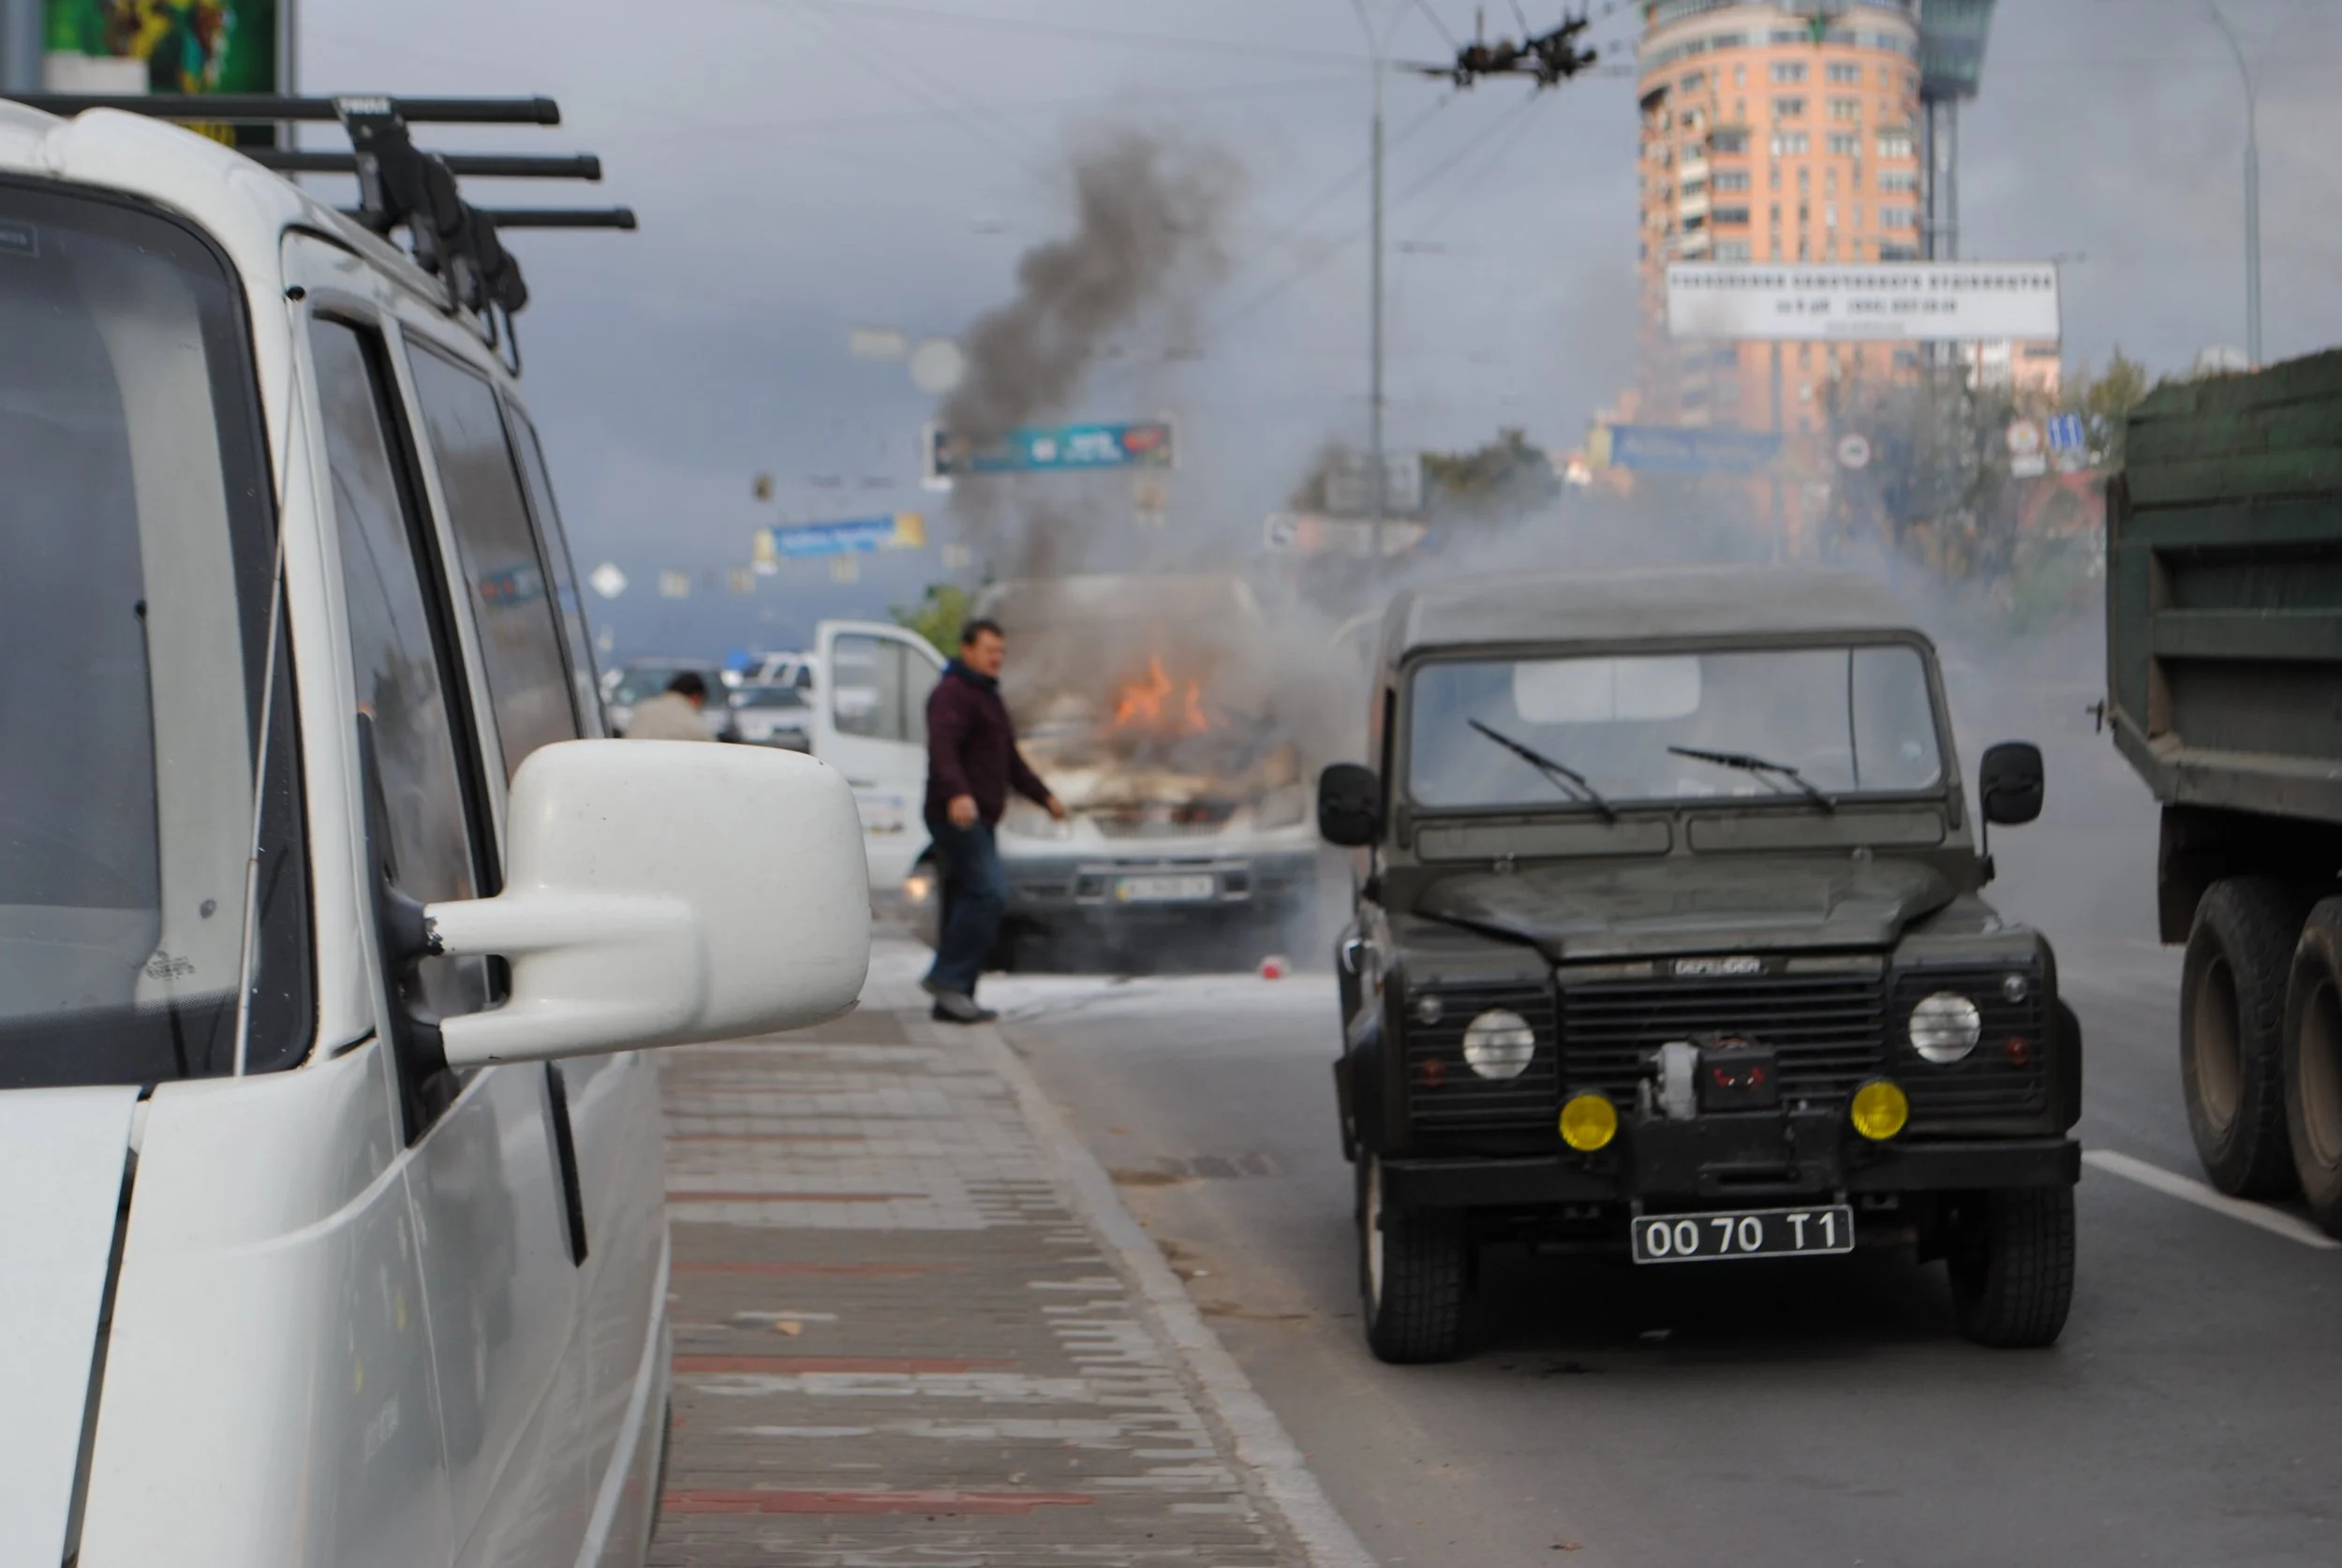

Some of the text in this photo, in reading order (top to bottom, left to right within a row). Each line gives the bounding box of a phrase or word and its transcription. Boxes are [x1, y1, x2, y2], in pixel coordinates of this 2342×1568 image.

[1646, 1213, 1836, 1256] 00 70 T1
